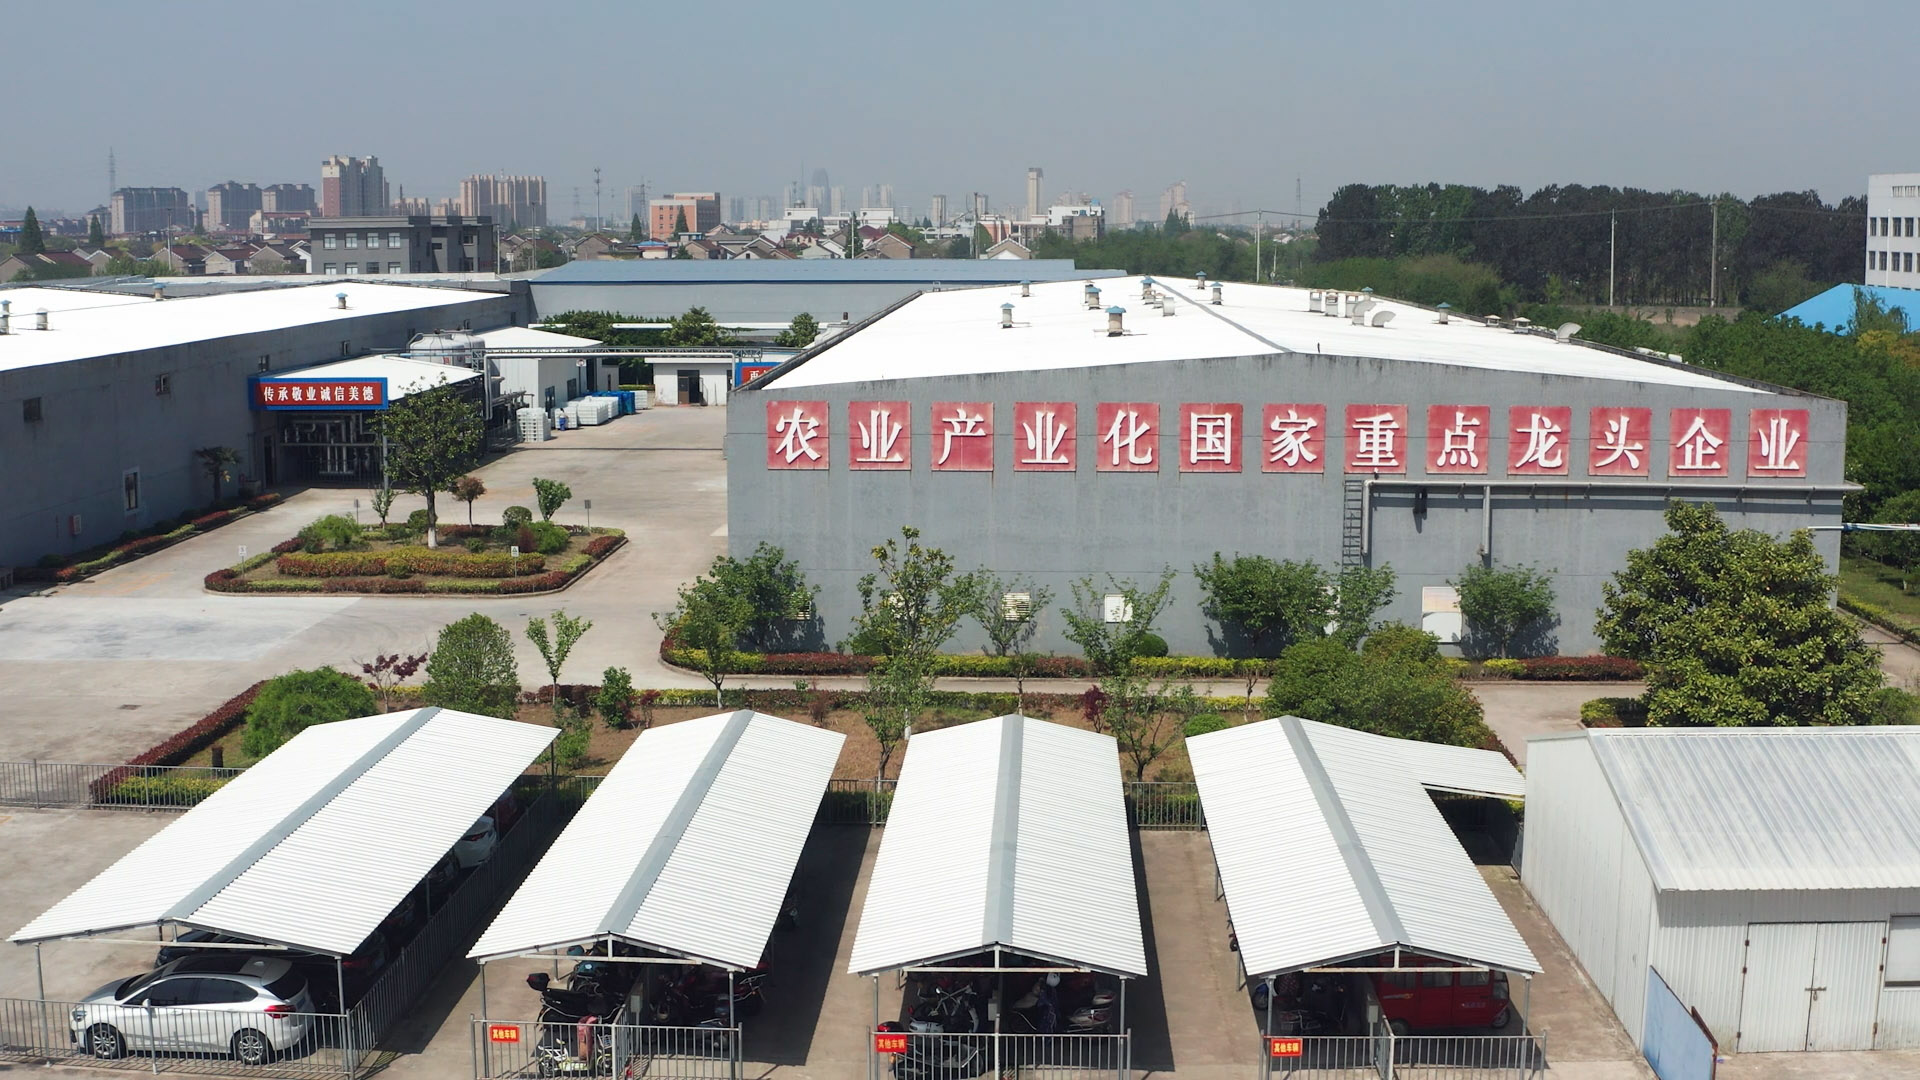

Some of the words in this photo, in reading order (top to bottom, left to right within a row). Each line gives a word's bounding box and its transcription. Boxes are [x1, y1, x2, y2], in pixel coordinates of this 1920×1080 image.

[264, 386, 374, 402] 传承敬业诚信美德
[774, 408, 1801, 470] 农业产业化国家重点龙头企业
